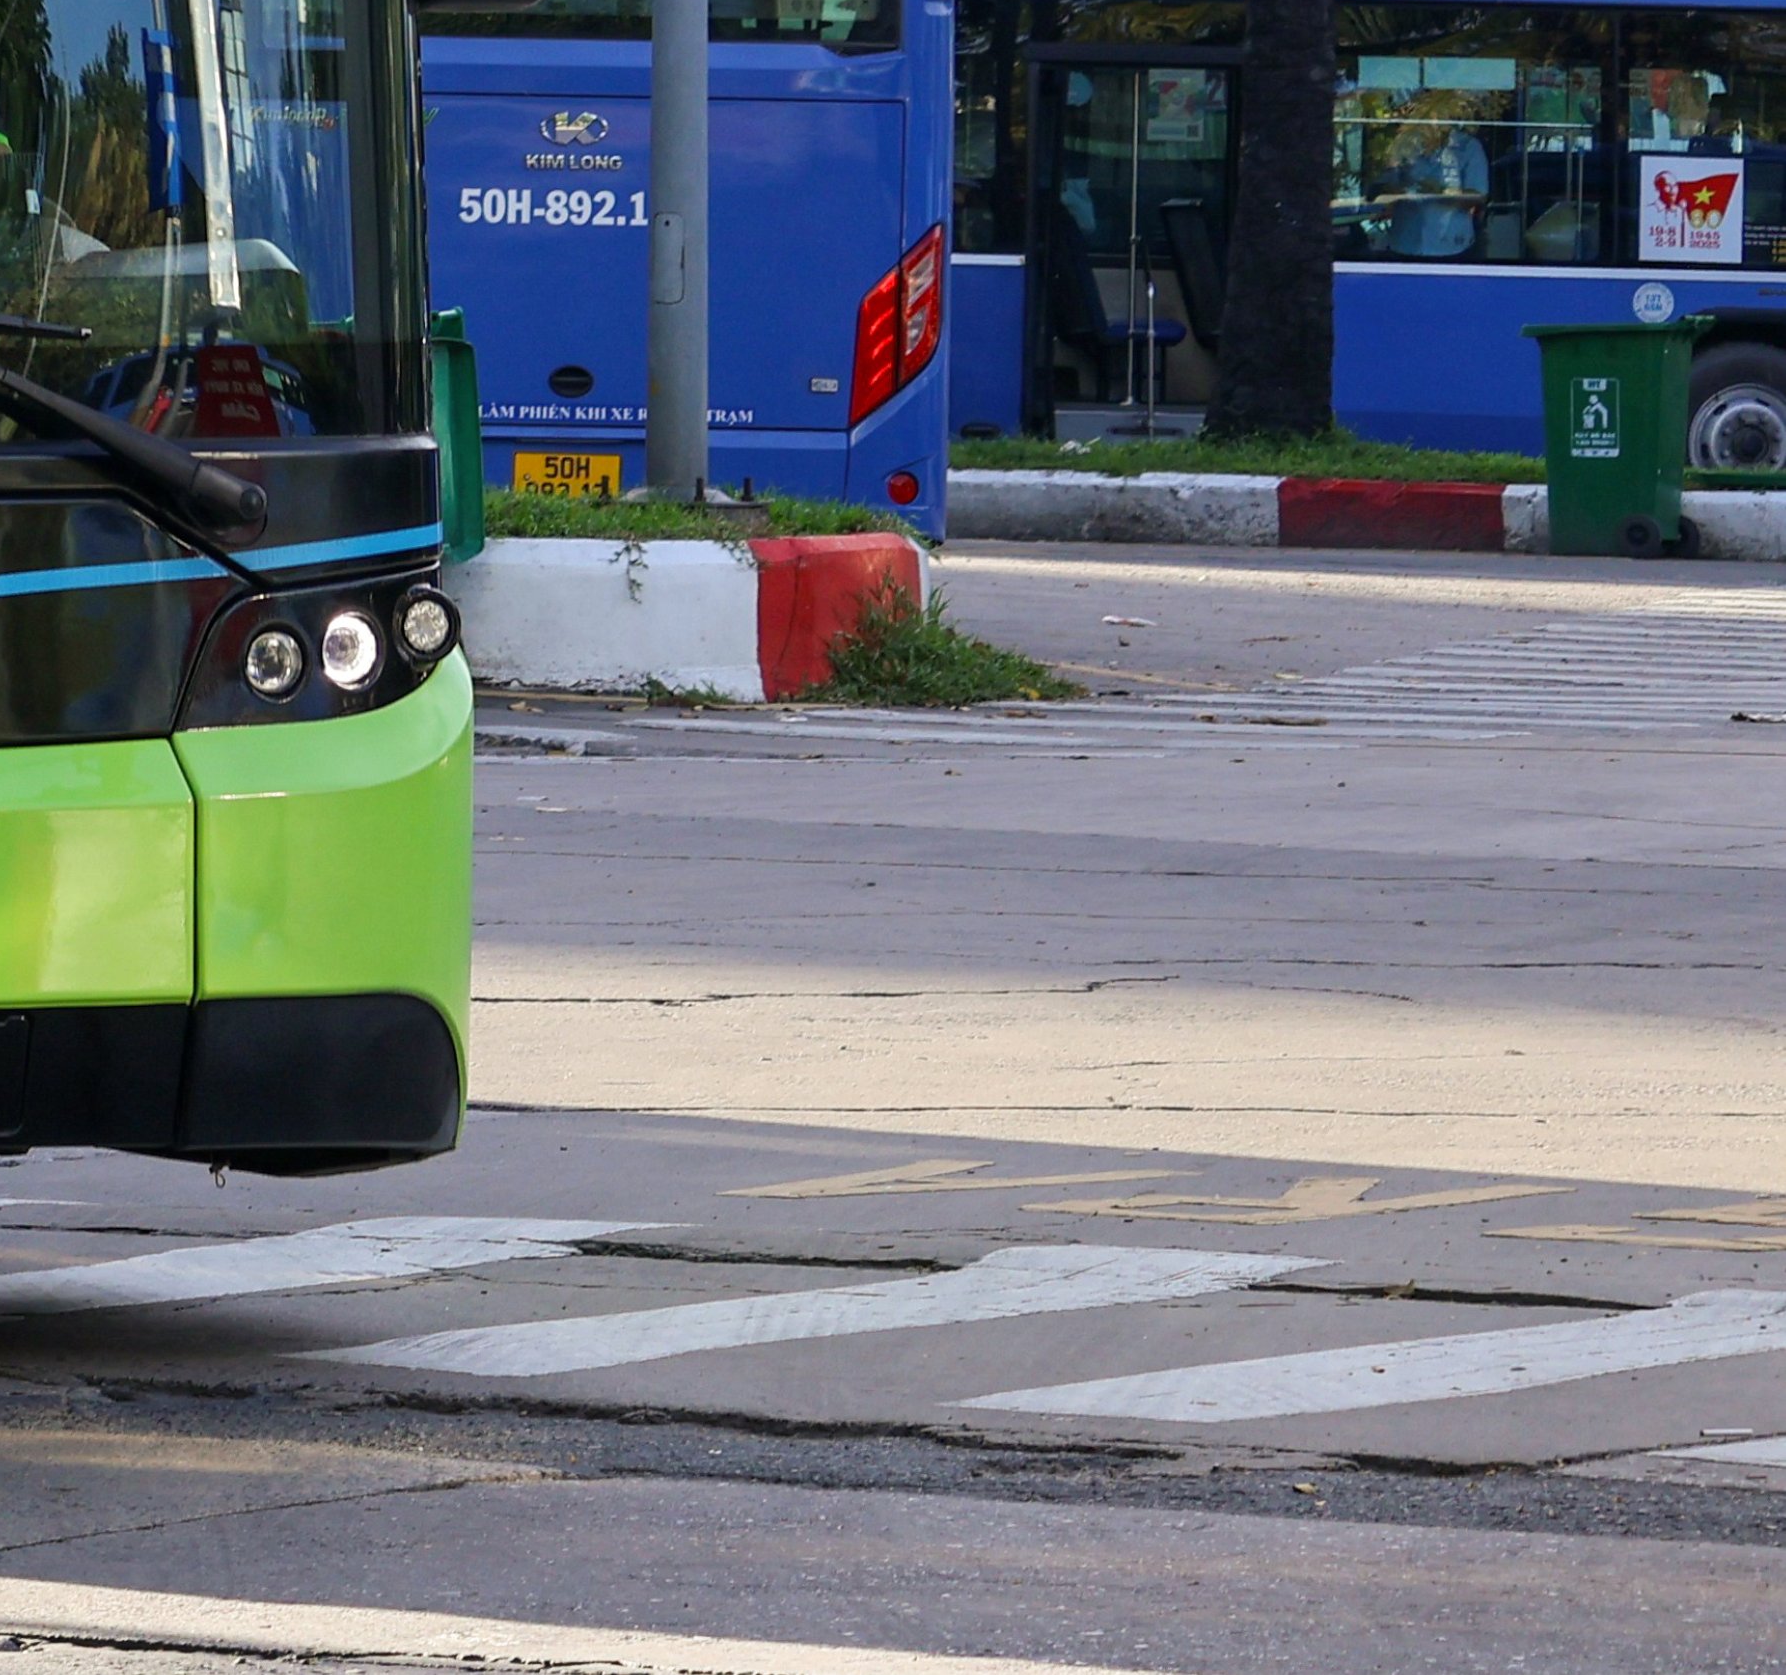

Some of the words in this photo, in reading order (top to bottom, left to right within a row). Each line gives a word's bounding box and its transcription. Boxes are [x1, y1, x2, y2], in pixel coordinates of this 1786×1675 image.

[525, 154, 565, 170] KIM
[570, 155, 623, 171] LONG
[458, 187, 649, 227] 50H-892.1
[478, 402, 515, 419] LÀM
[575, 407, 607, 421] KHI
[611, 407, 634, 422] XE
[544, 456, 591, 480] 50H
